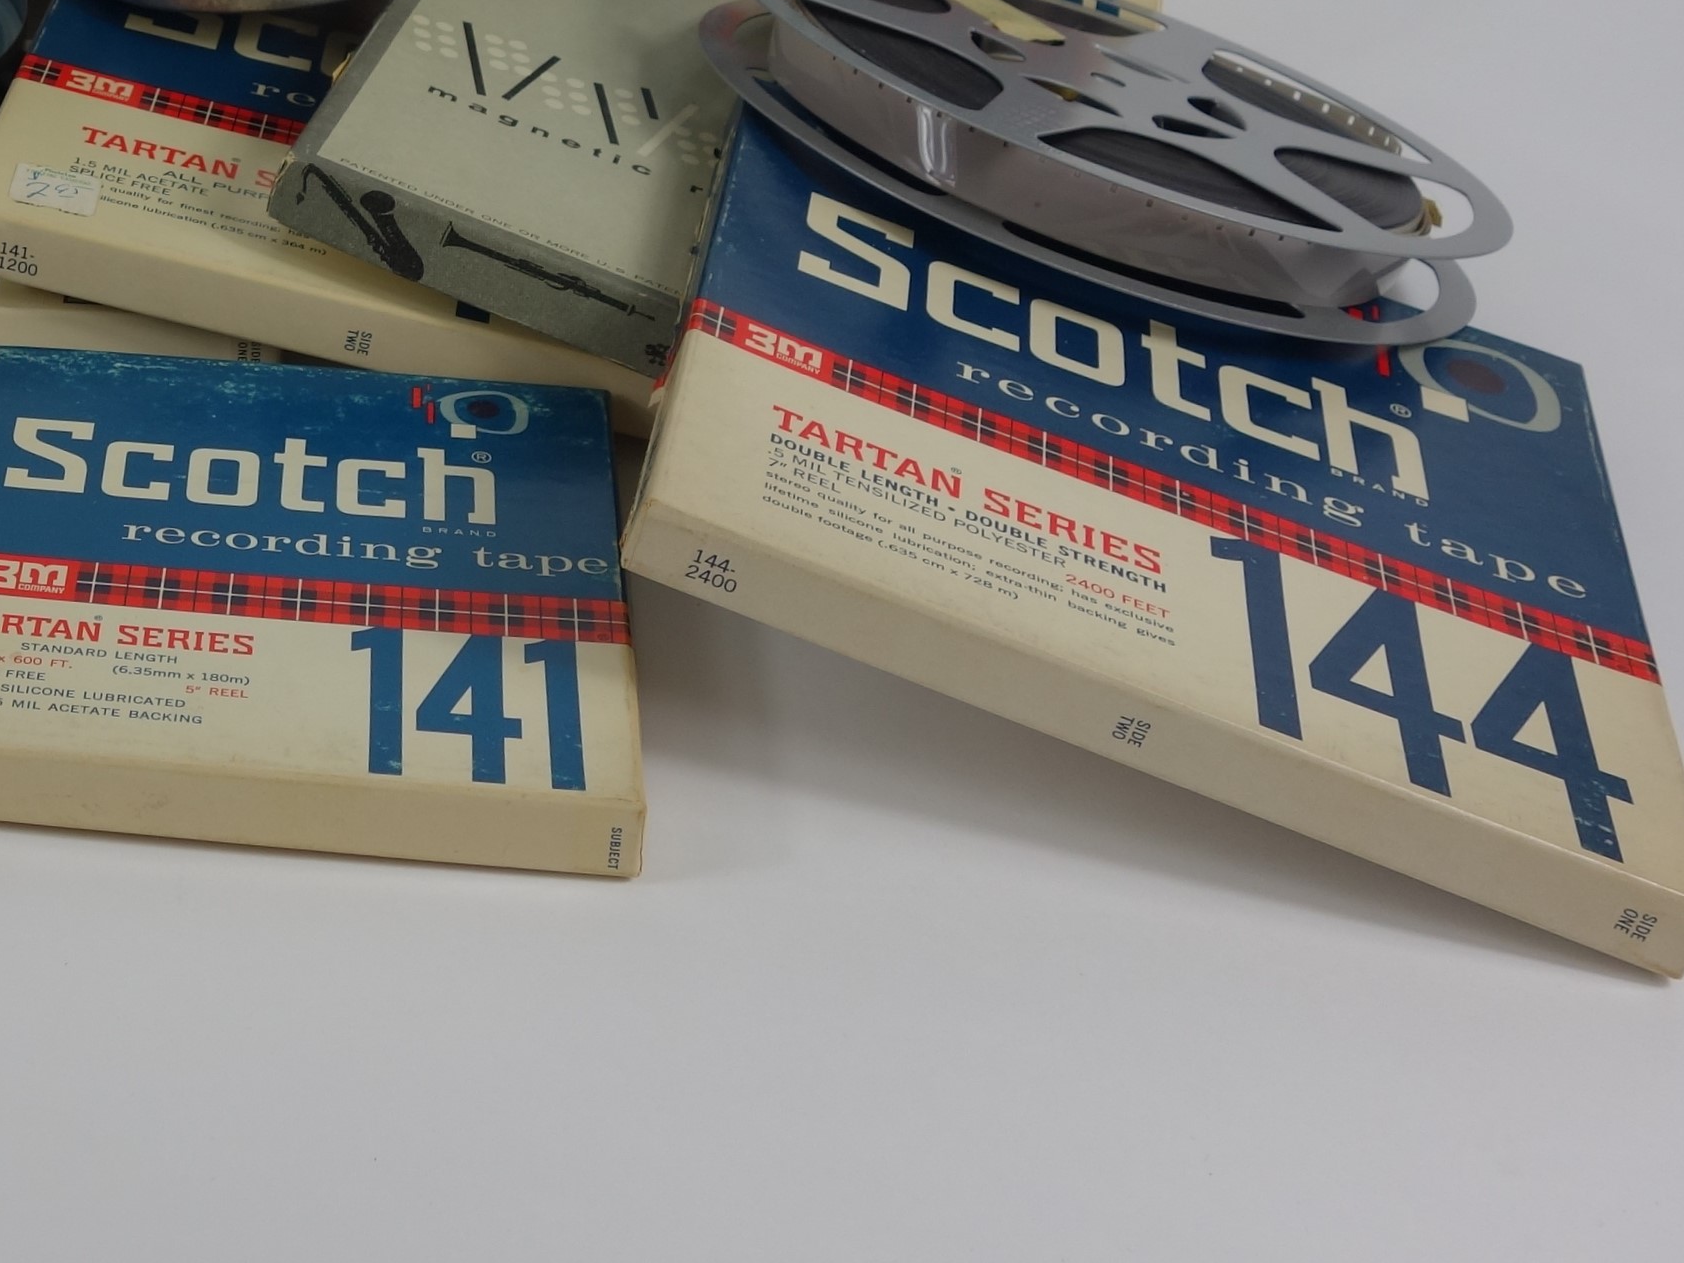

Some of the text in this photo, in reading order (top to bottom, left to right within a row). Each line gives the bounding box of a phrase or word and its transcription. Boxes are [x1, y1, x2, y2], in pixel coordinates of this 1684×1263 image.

[427, 85, 652, 176] magnetic
[81, 125, 241, 180] TARTAN
[69, 164, 125, 186] SPLICE
[131, 180, 172, 197] FREE
[102, 163, 132, 178] MIL
[136, 172, 210, 197] ACETATE
[163, 170, 206, 186] ALL
[0, 241, 36, 261] 141-
[344, 329, 359, 352] TWO
[356, 331, 373, 356] SIDE
[744, 323, 823, 369] 3M
[796, 189, 1430, 504] Scotch
[3, 417, 497, 526] Scotch
[793, 467, 842, 494] REEL
[955, 358, 1588, 604] recording tape
[1329, 465, 1430, 510] BRAND
[773, 404, 1162, 575] TARTAN SERIES
[762, 494, 874, 544] double footage
[770, 432, 1167, 594] DOUBLE LENGTH DOUBLE STRENGTH
[792, 455, 1067, 569] MIL TENSILIZED POLYESTER
[422, 525, 497, 538] BRAND
[120, 521, 609, 577] recording tape
[693, 549, 736, 573] 144-
[764, 481, 1176, 647] lifetime silicone backing gives
[766, 470, 1175, 634] stereo quality for purpose has exclusive
[17, 583, 66, 595] COMPANY
[685, 564, 738, 593] 2400
[1065, 573, 1171, 619] 2400 FEET
[20, 641, 178, 664] STANDARD LENGTH
[117, 624, 255, 656] SERIES
[5, 669, 47, 682] FREE
[208, 687, 250, 699] REEL
[13, 654, 251, 686] 600 (6.35mm 180m)
[0, 683, 186, 709] SILICONE LUBRICATED
[11, 698, 42, 711] MIL
[48, 702, 122, 718] ACETATE
[128, 709, 204, 725] BACKING
[350, 626, 588, 792] 141
[1209, 533, 1634, 864] 144
[1112, 715, 1136, 740] TWO
[1126, 720, 1152, 748] SIDE
[606, 826, 624, 871] SUBJECT
[1613, 908, 1638, 934] ONE
[1629, 913, 1658, 942] SIDE
